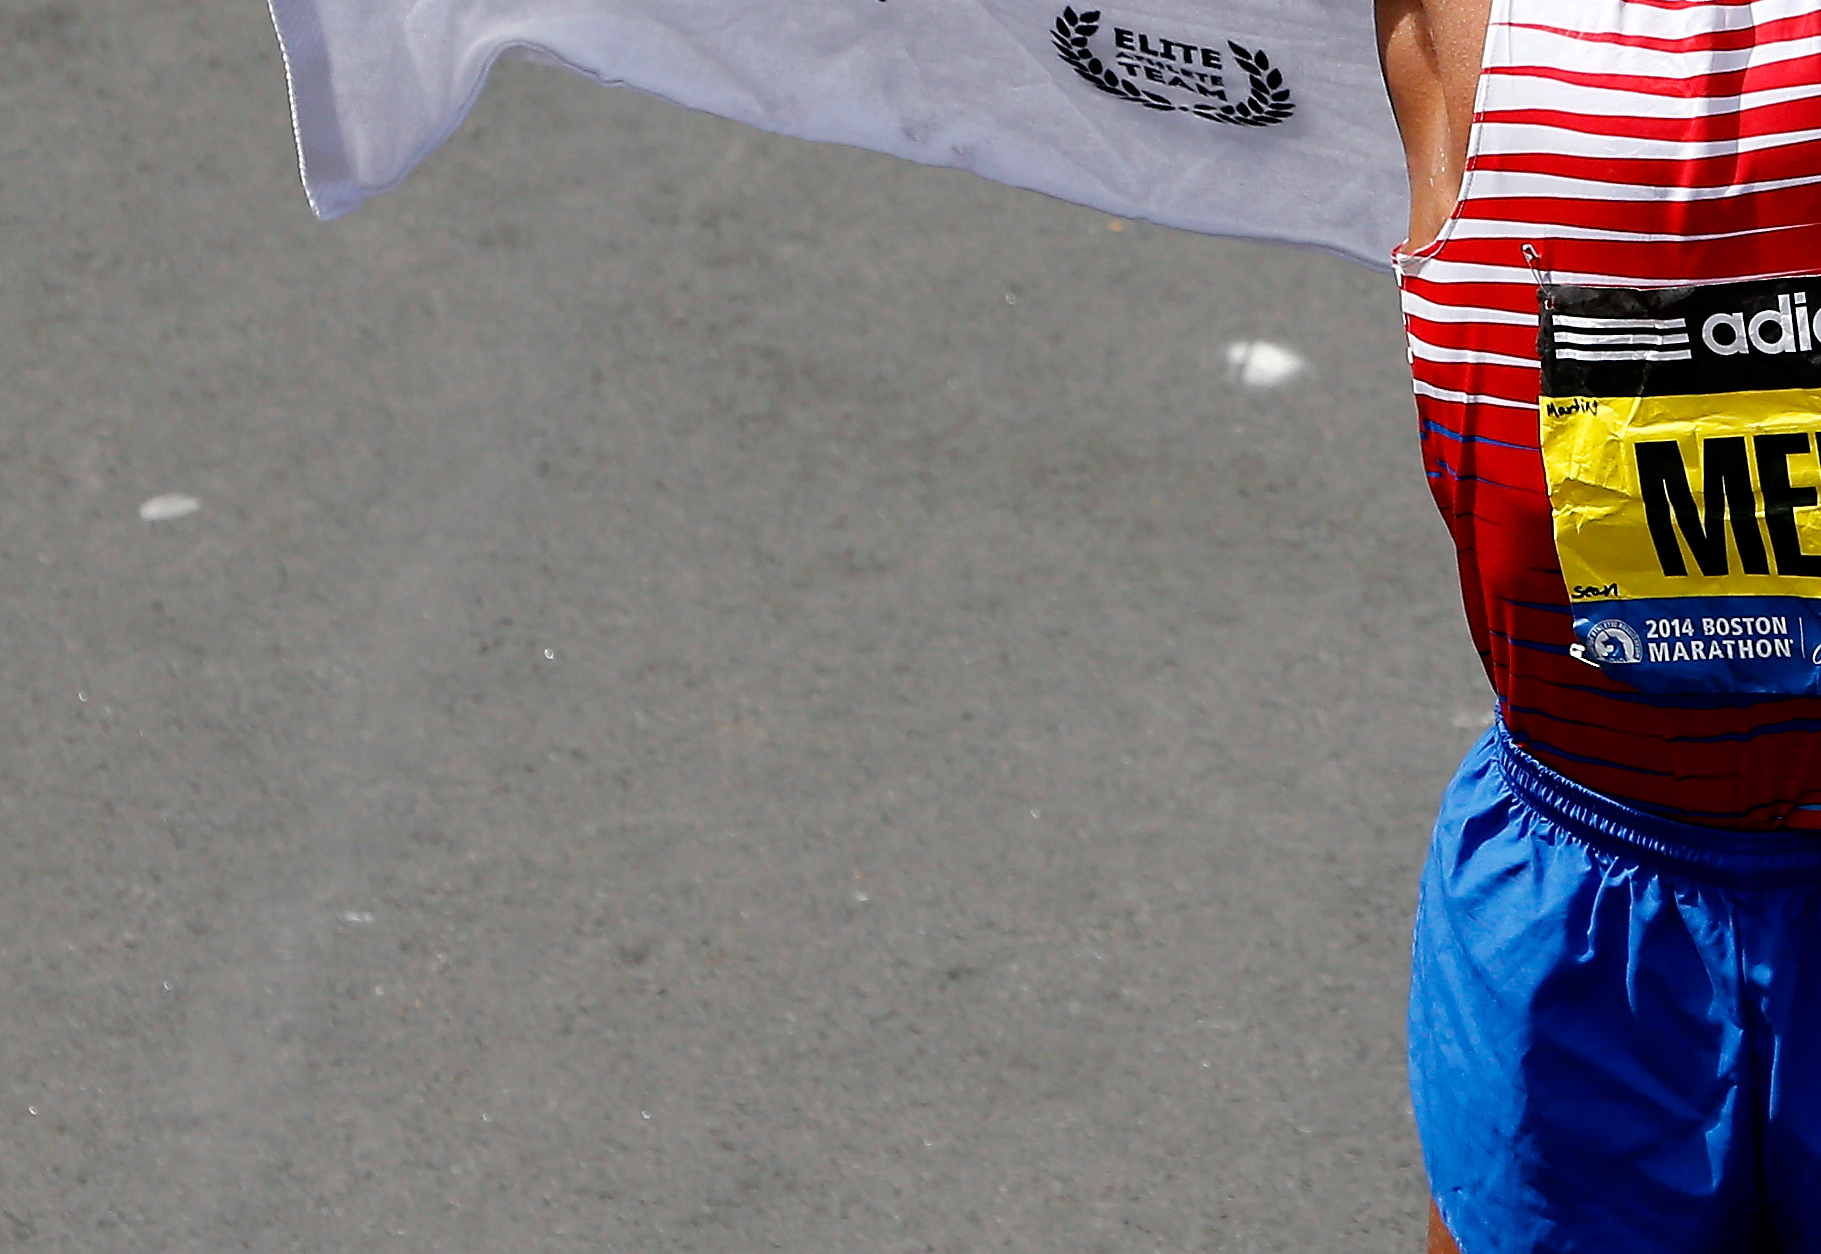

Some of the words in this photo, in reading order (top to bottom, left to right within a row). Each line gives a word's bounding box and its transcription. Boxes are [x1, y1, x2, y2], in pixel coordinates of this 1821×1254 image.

[1114, 27, 1223, 70] ELITE
[1118, 61, 1228, 102] TEAM
[1645, 618, 1695, 639] 2014
[1702, 616, 1788, 636] BOSTON
[1648, 638, 1793, 663] MARATHON
